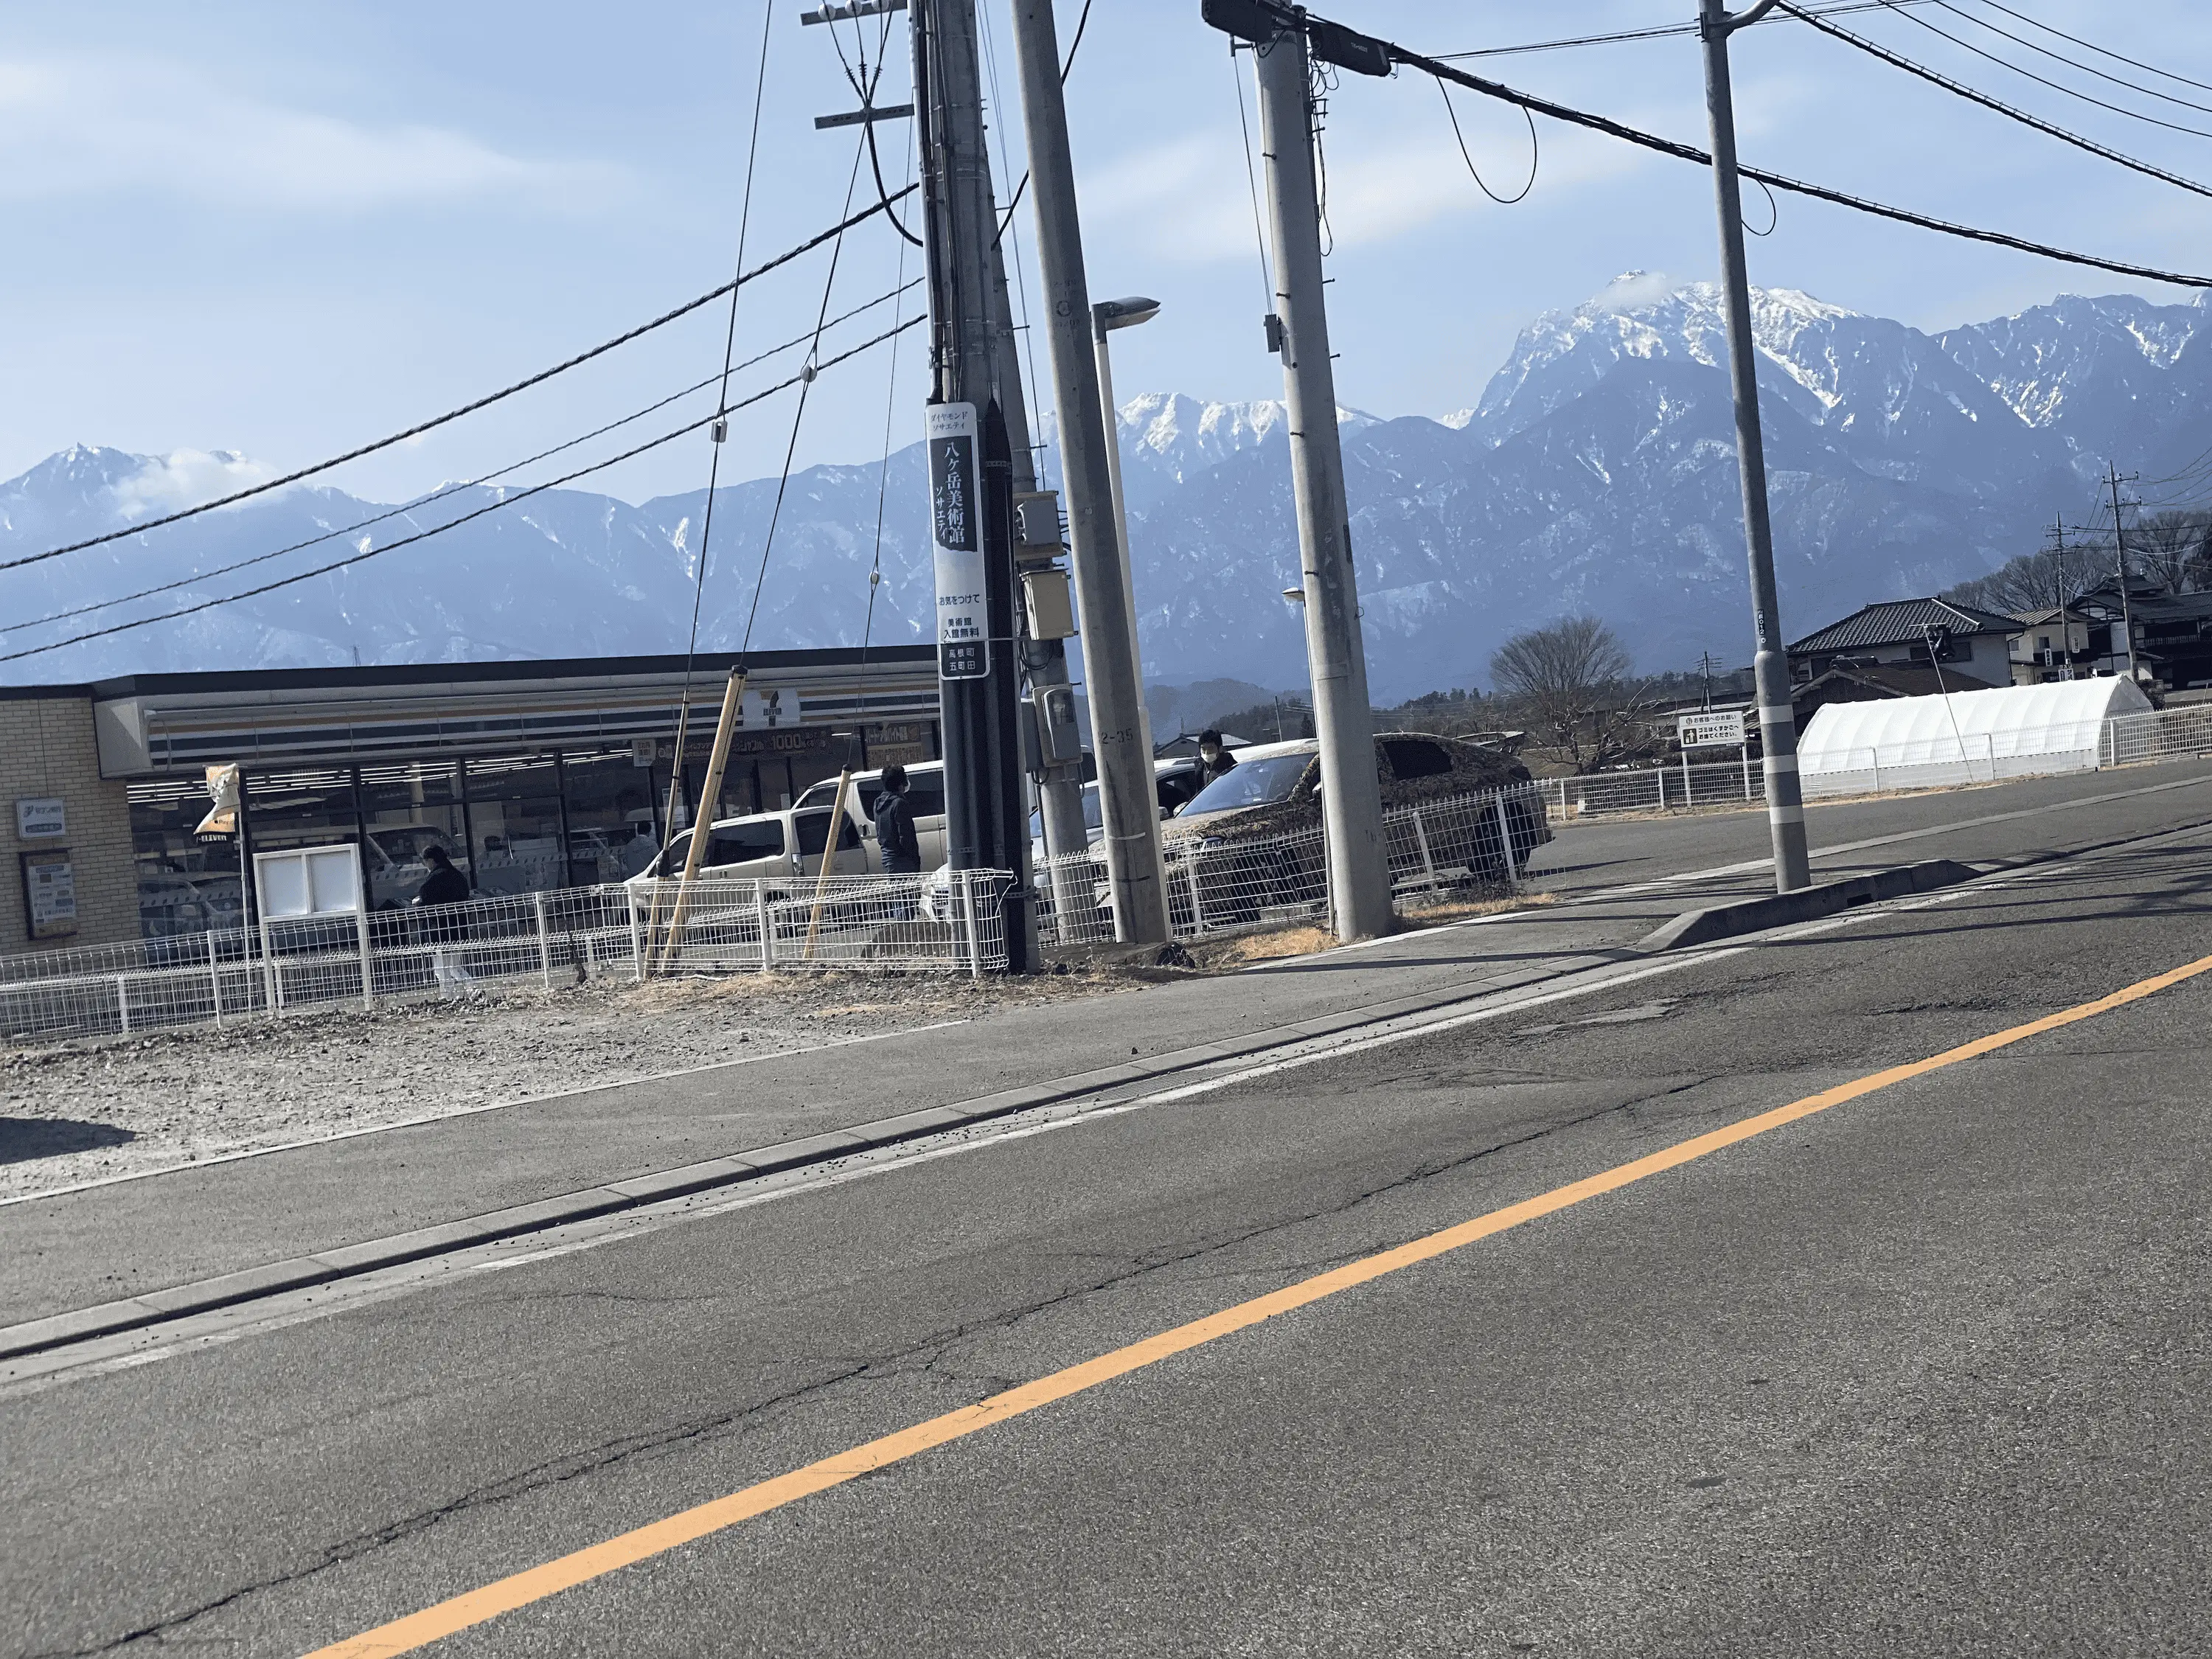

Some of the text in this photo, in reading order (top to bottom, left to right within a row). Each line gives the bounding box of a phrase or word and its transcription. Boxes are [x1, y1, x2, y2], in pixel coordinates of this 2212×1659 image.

[939, 594, 980, 606] お気をつけて
[947, 617, 973, 627] 美術館
[944, 627, 980, 639] 入館無料
[949, 647, 975, 658] 高根町
[950, 660, 975, 672] 五町田
[1694, 714, 1736, 723] お客様へのお願い
[1101, 728, 1133, 745] 2-35
